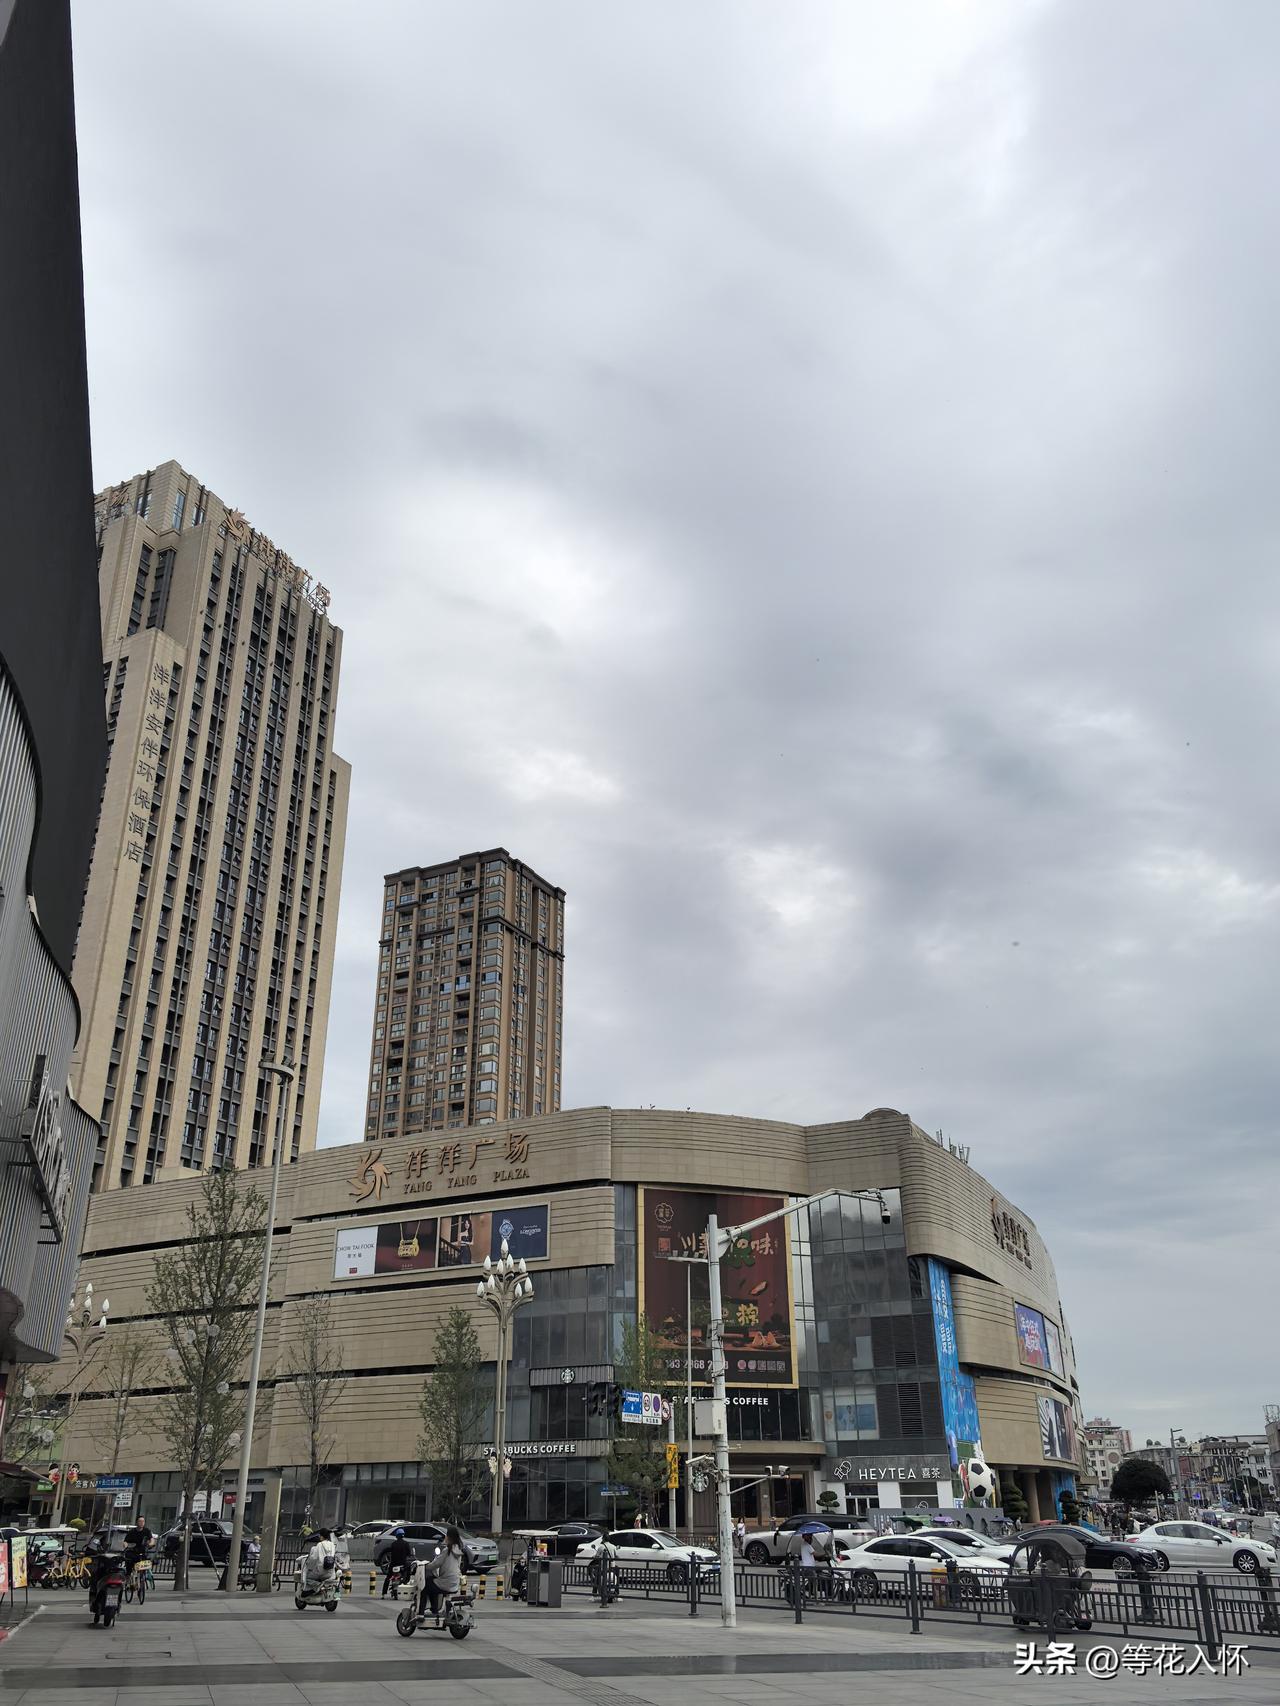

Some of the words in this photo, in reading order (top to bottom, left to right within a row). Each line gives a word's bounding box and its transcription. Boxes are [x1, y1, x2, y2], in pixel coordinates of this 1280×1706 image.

[123, 662, 170, 864] 洋洋安伴环保酒店
[405, 1131, 531, 1180] 洋洋广场
[403, 1181, 433, 1194] YANG
[447, 1175, 478, 1188] YANG
[492, 1167, 531, 1182] PLAZA
[732, 1397, 769, 1406] COFFEE
[483, 1445, 539, 1456] STRBUCKS
[540, 1444, 576, 1454] COFFEE
[858, 1467, 917, 1480] HEYTEA
[921, 1467, 941, 1479] 喜茶
